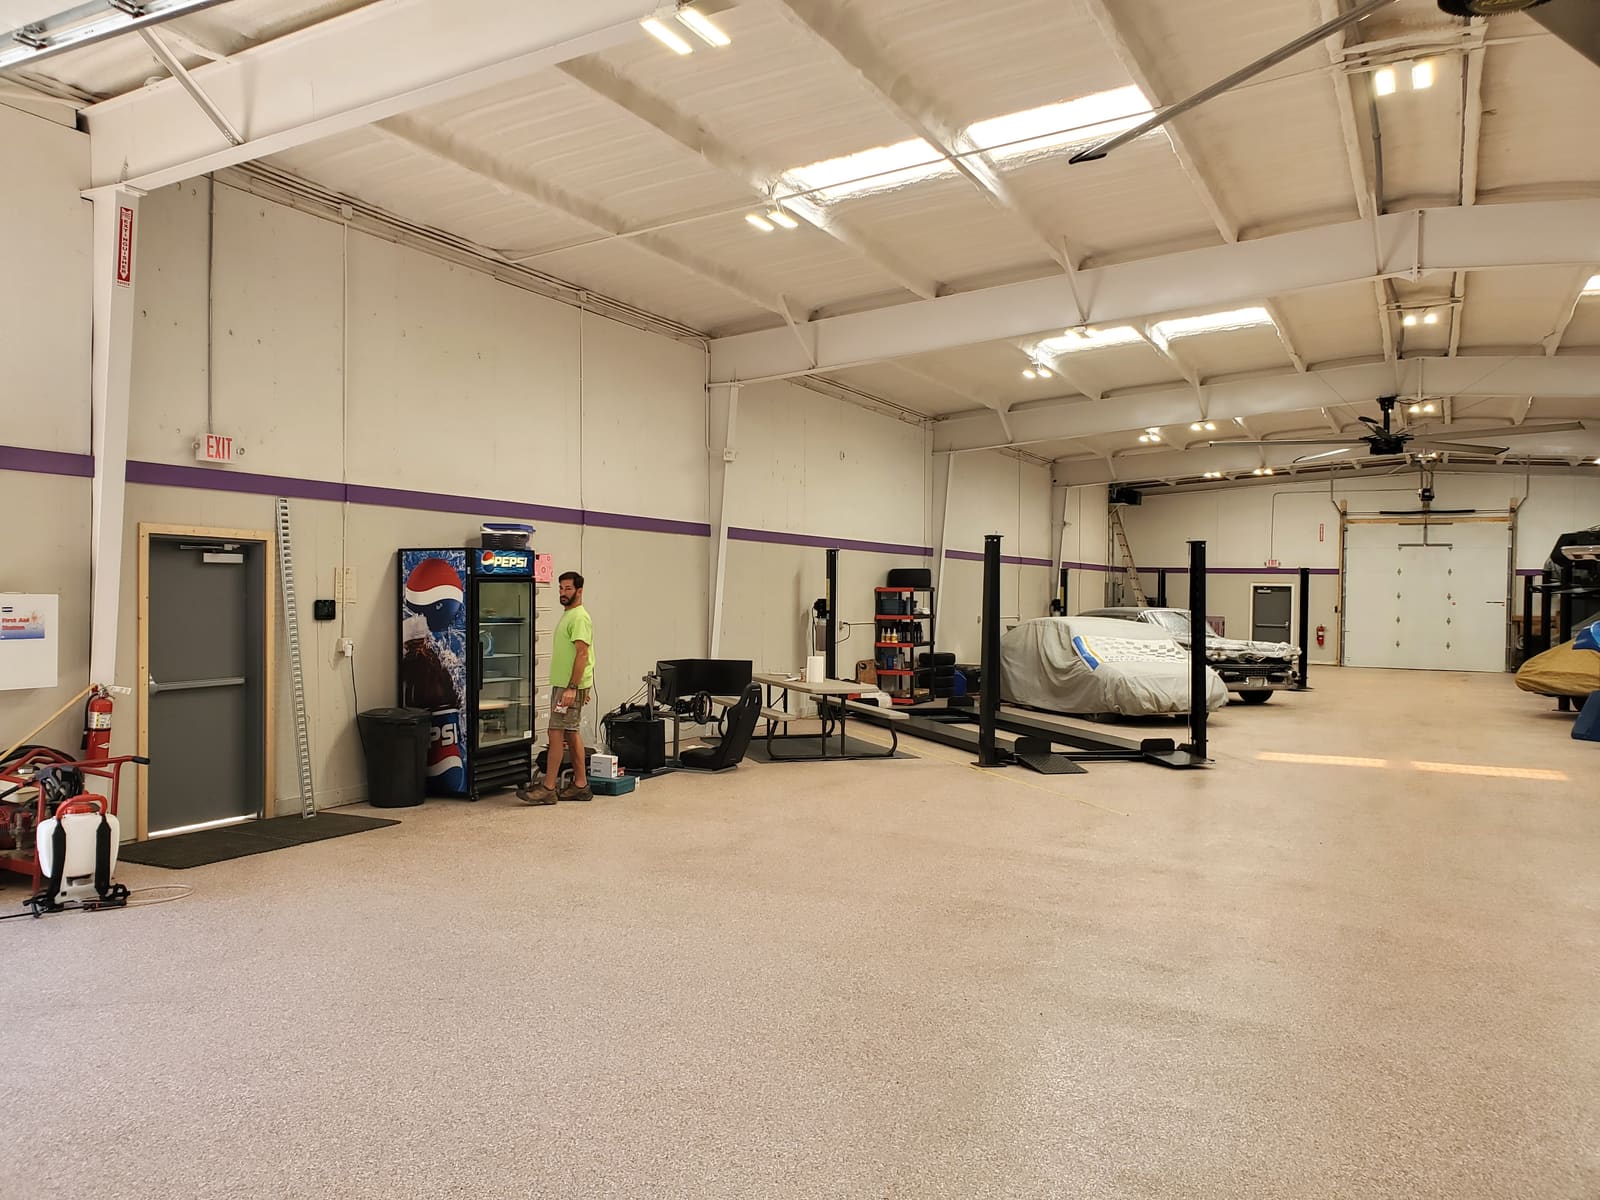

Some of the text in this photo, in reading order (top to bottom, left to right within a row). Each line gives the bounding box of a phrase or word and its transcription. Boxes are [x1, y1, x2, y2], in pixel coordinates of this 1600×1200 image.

[206, 434, 233, 460] EXIT
[493, 556, 528, 568] PEPSI
[430, 722, 458, 746] PSI
